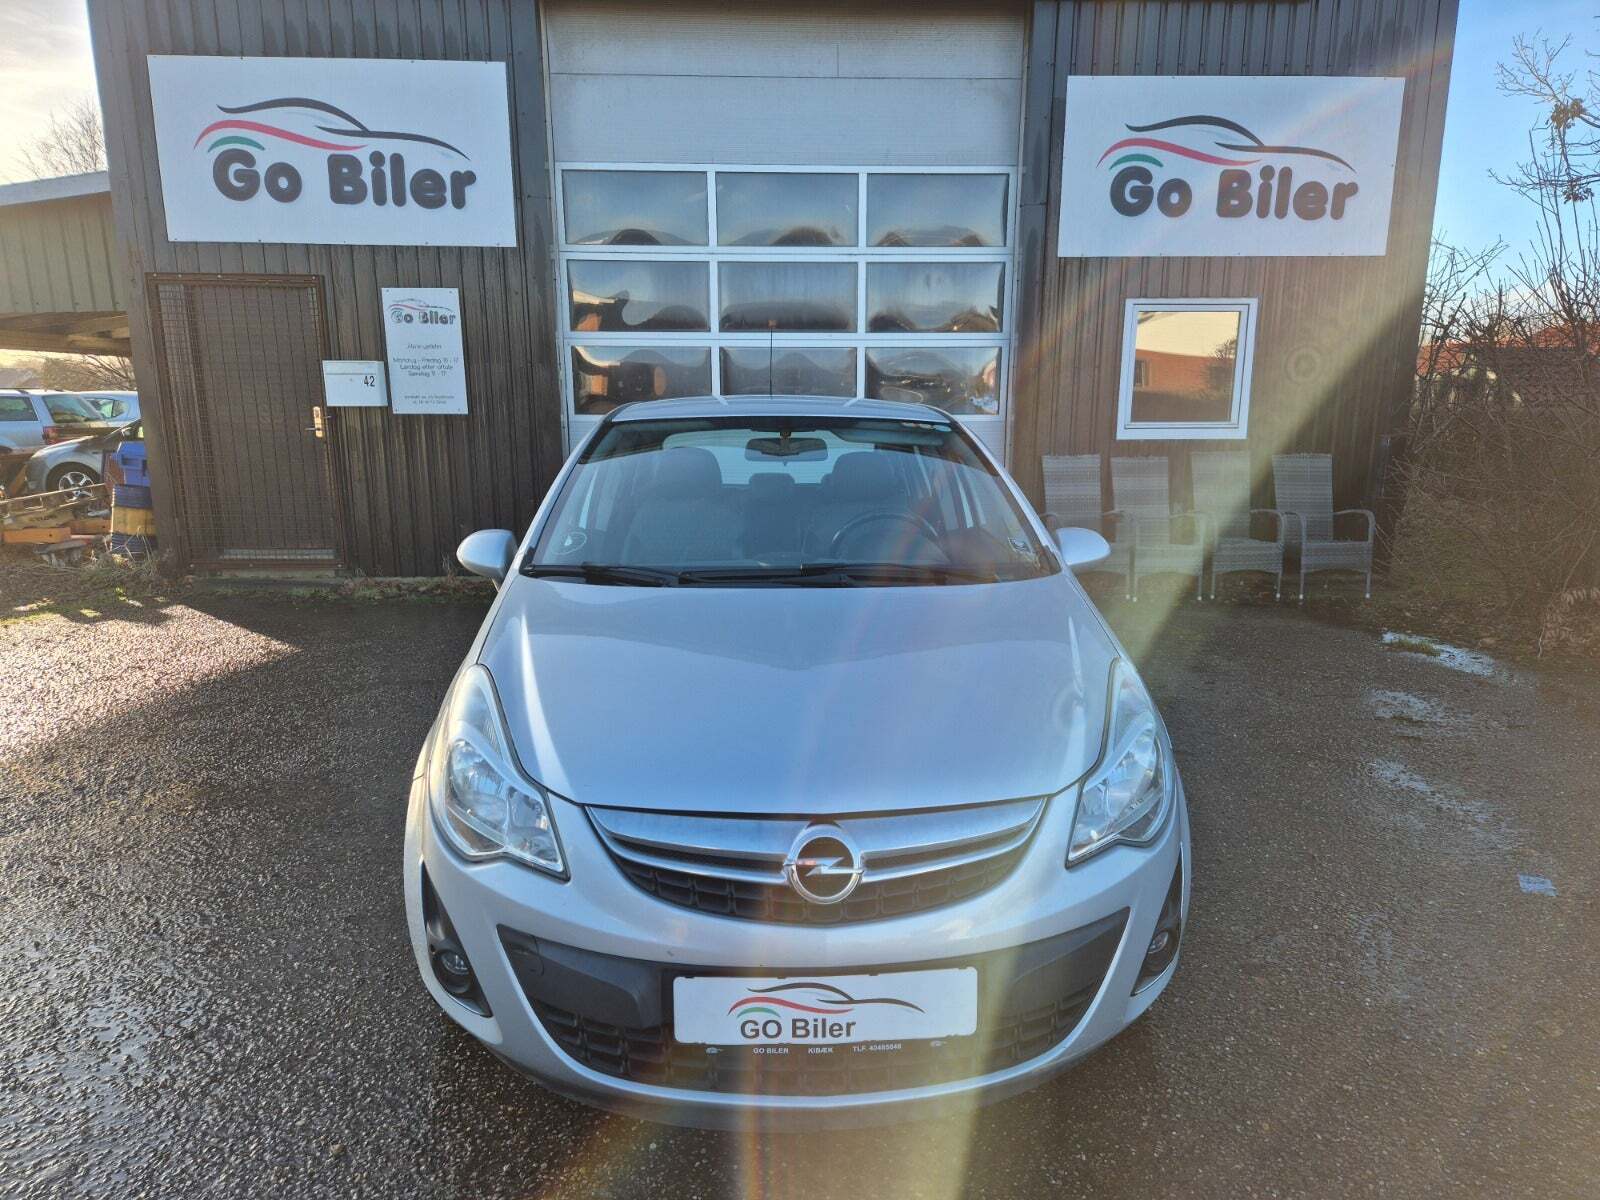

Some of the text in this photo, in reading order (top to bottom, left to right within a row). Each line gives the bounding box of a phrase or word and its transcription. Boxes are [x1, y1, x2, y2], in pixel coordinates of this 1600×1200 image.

[212, 148, 477, 210] Go Biler
[1109, 165, 1359, 221] Go Biler
[391, 310, 456, 325] Go Biler
[364, 375, 375, 387] 42
[740, 1018, 857, 1039] GO Biler
